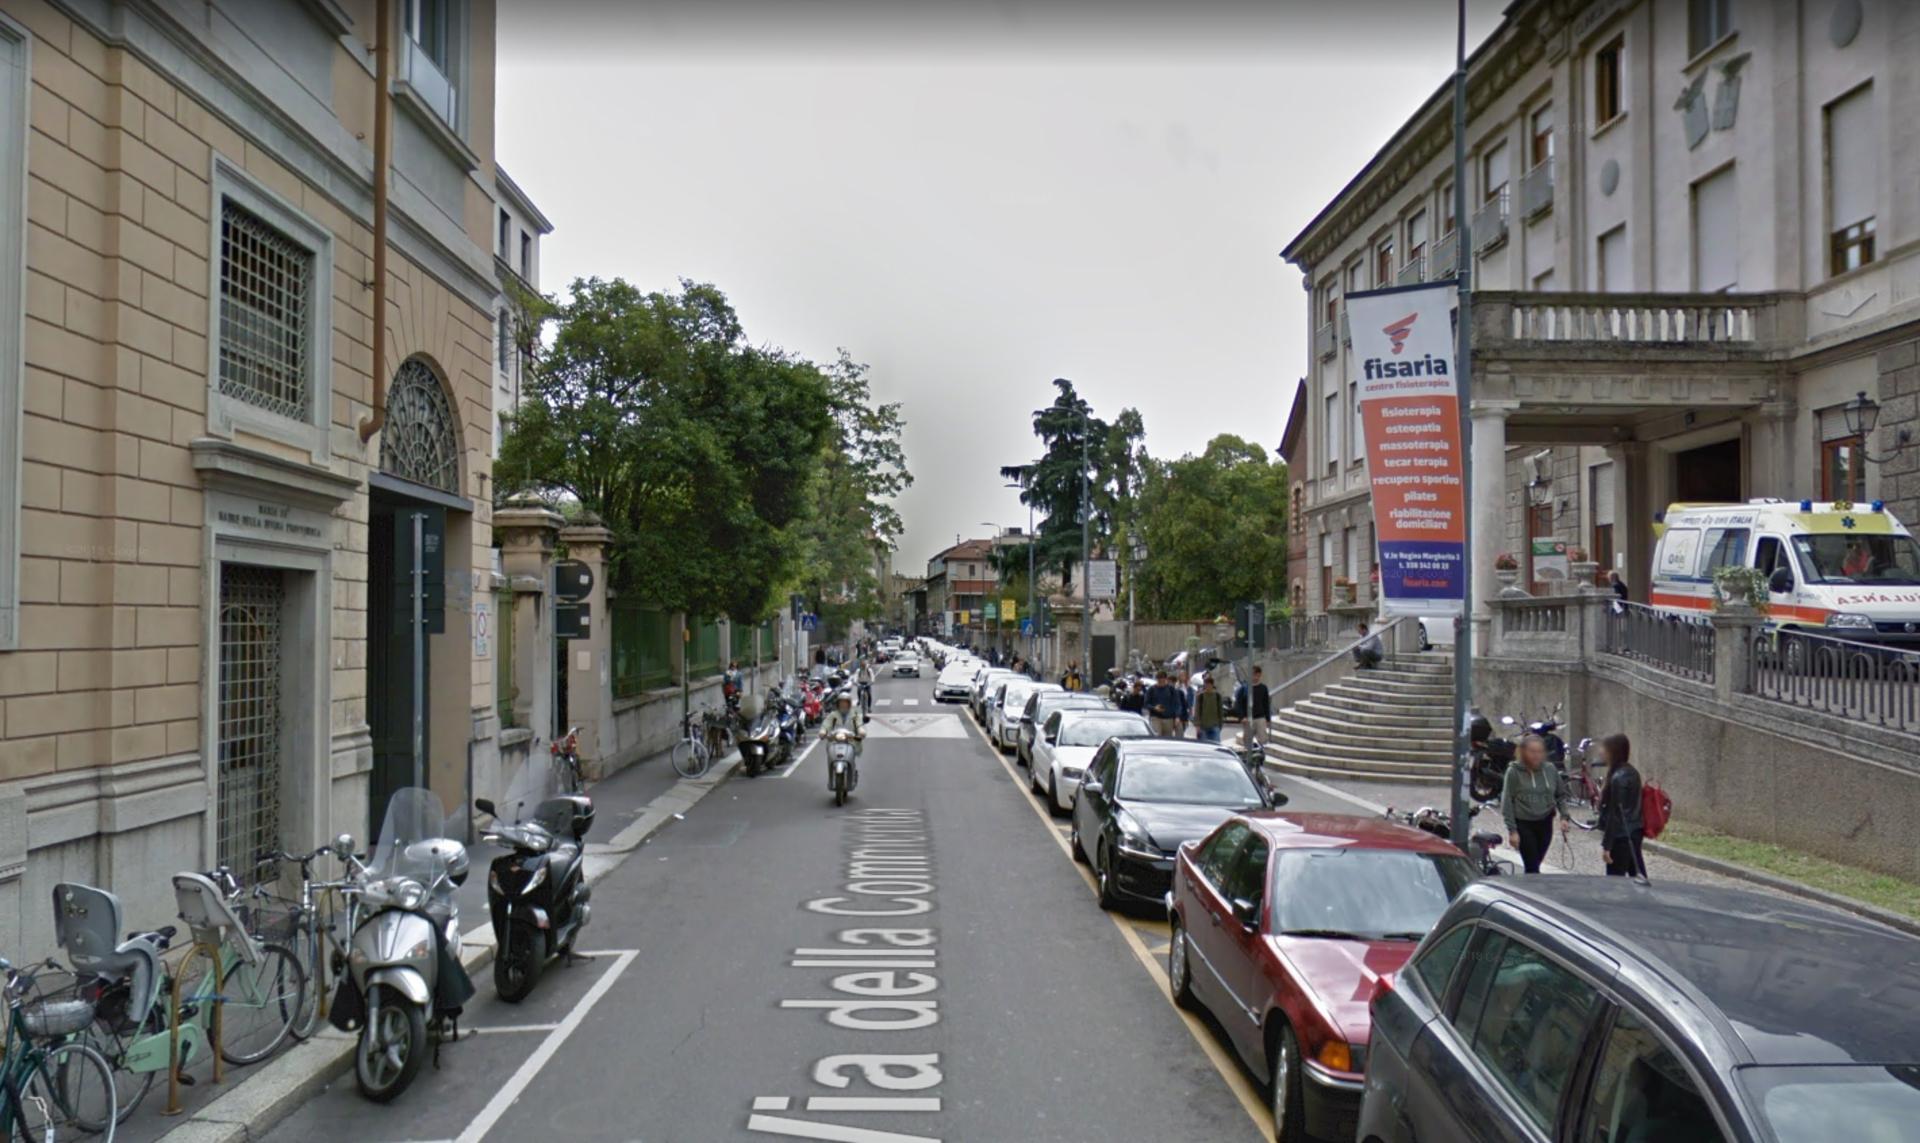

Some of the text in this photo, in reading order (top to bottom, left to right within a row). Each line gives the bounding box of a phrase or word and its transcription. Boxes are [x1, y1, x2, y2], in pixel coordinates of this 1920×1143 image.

[1364, 354, 1448, 379] fisaria
[1365, 382, 1394, 392] centro
[1381, 406, 1442, 418] fisioterapia
[1386, 422, 1442, 434] osteopatia
[1379, 440, 1449, 452] massoterapia
[1384, 457, 1449, 469] tecar terapia
[1373, 474, 1460, 486] recupero sportivo
[1404, 491, 1437, 503] pilates
[1389, 508, 1452, 519] riabilitazione
[1396, 519, 1448, 530] domiciliare
